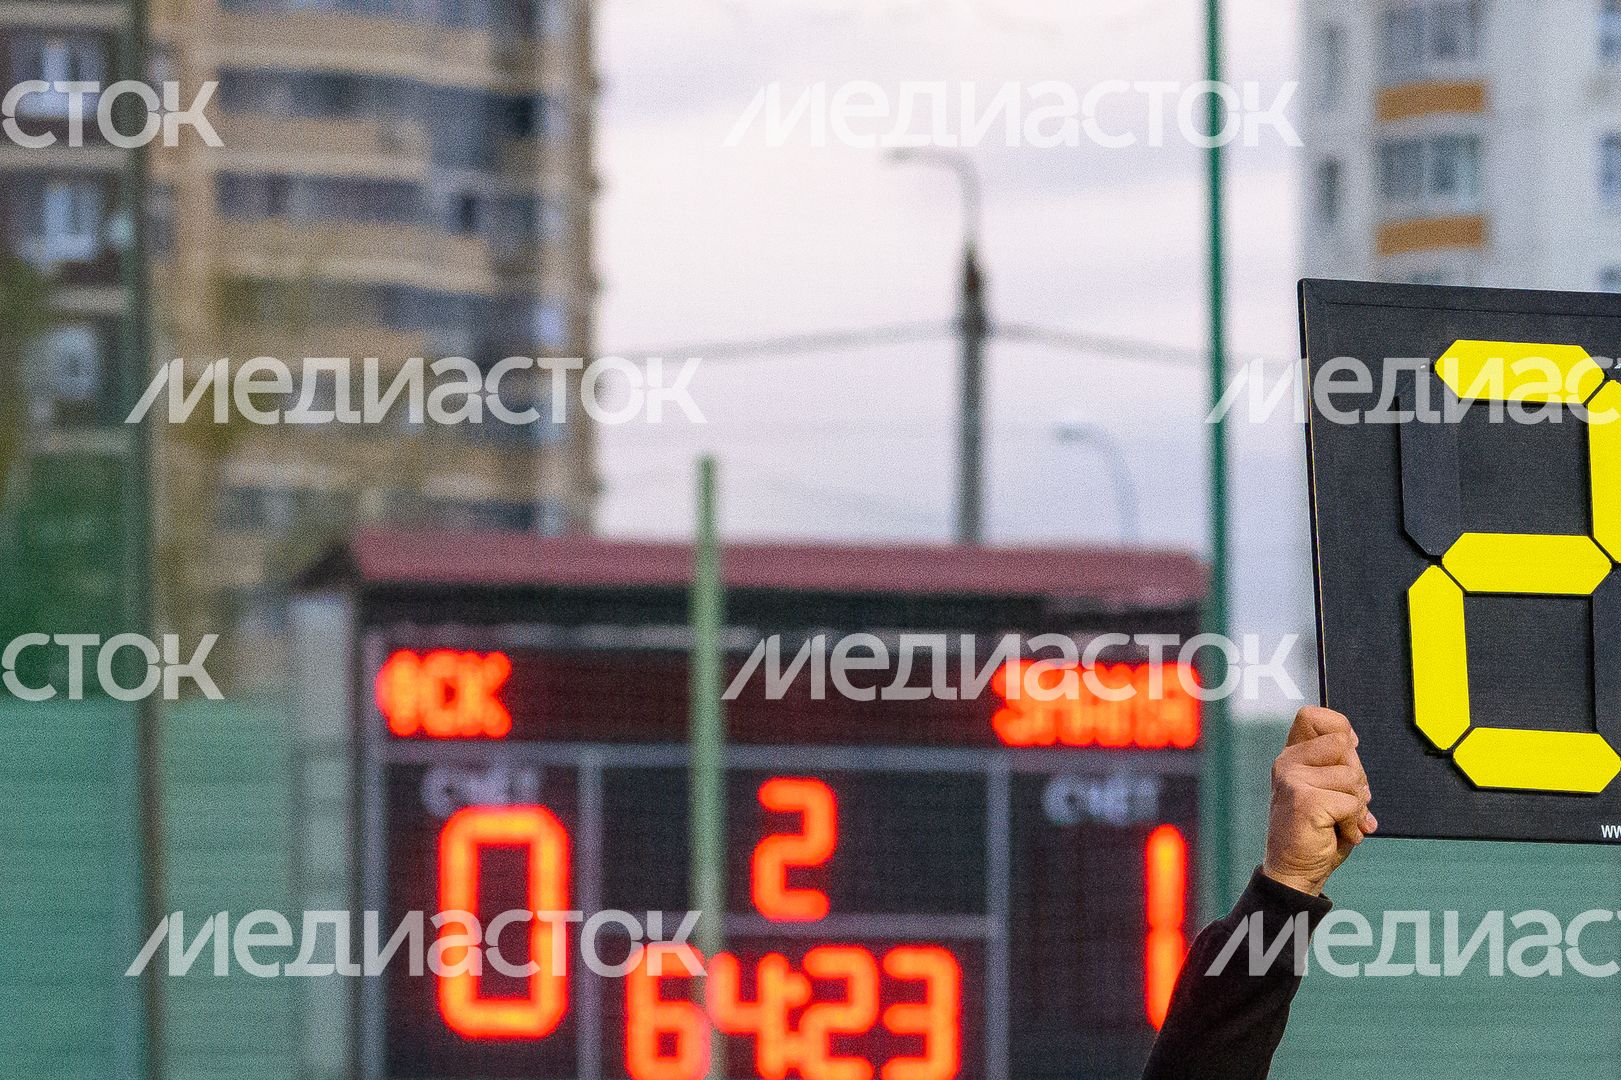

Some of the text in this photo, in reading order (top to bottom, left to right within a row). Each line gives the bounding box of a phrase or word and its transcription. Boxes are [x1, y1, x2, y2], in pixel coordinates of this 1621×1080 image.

[438, 804, 570, 1040] 0
[752, 777, 838, 922] 2
[1145, 824, 1188, 1031] 1
